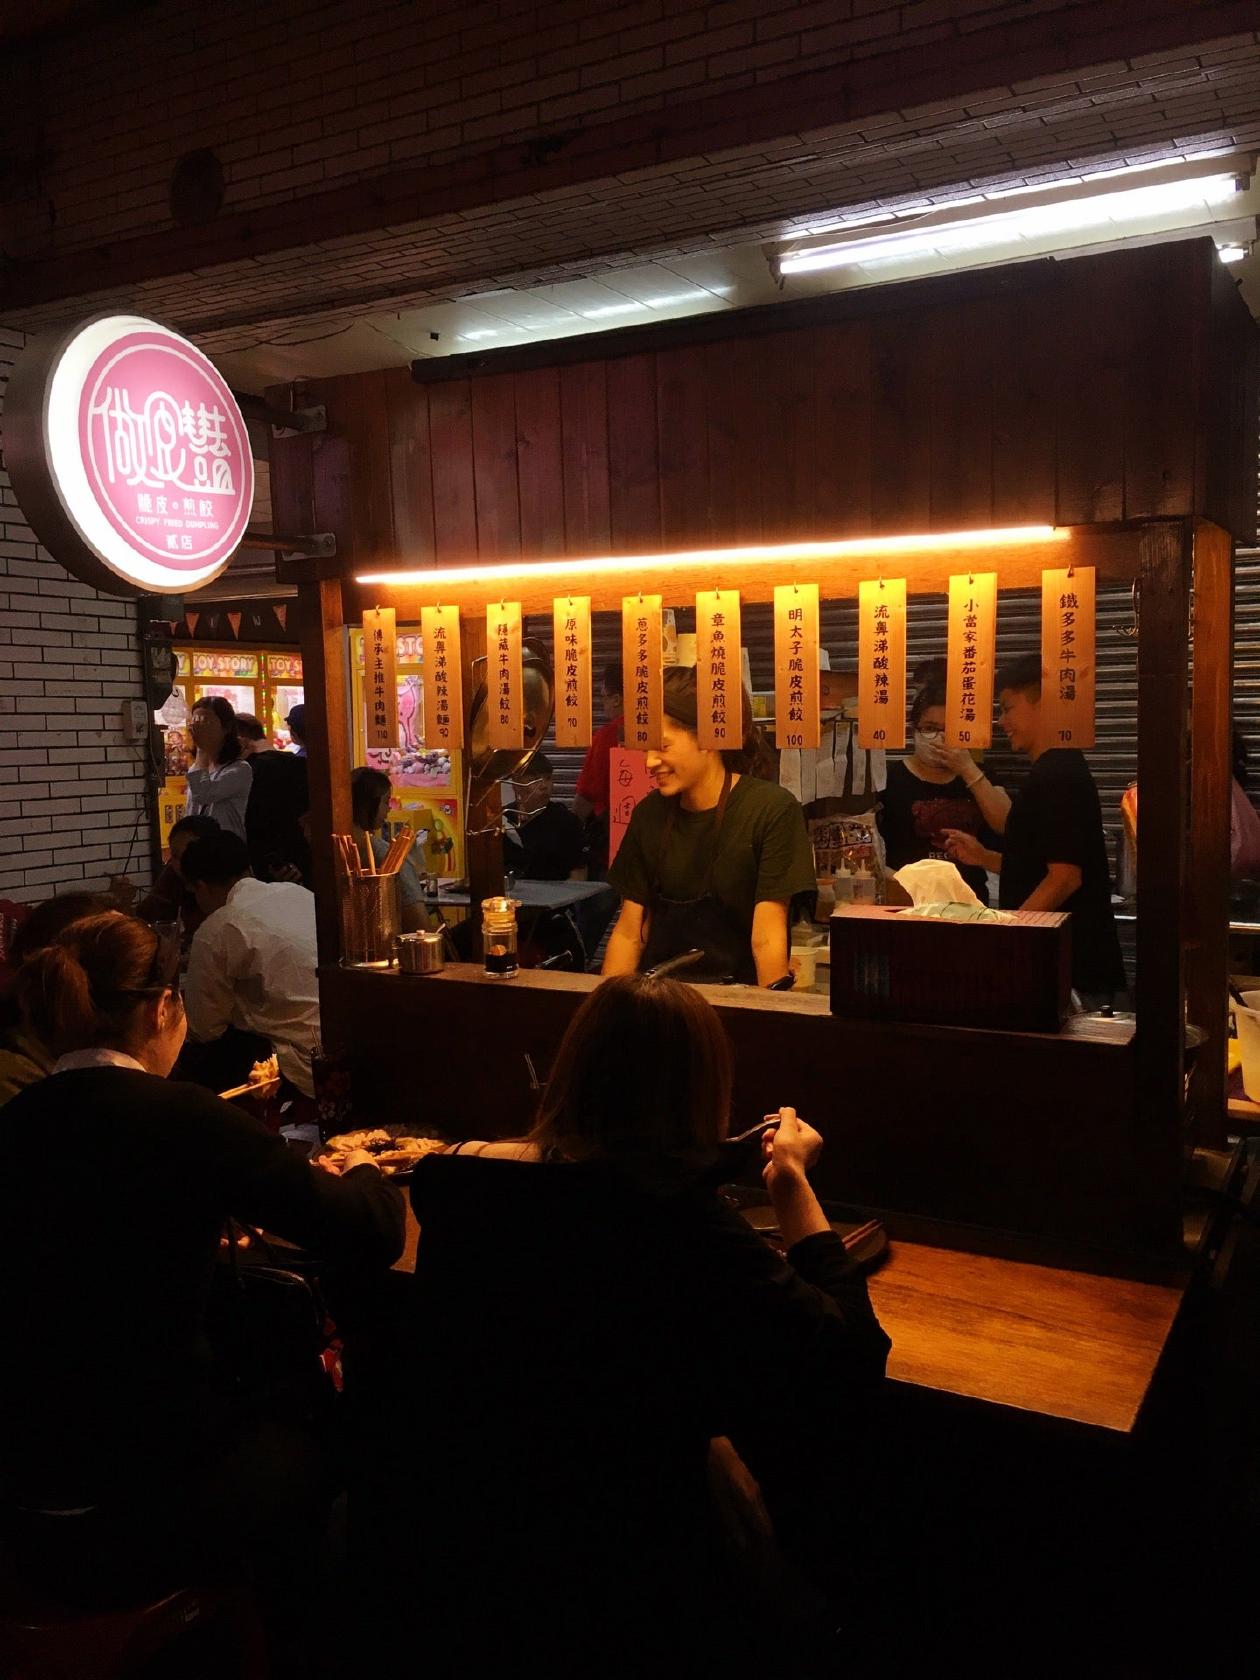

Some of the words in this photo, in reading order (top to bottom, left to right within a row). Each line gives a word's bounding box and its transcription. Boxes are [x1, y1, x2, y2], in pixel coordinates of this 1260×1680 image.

[135, 515, 161, 527] CRISPY
[163, 518, 184, 528] FRIED
[1058, 592, 1080, 702] 鐵多多牛肉湯
[872, 604, 891, 705] 流鼻涕酸辣湯
[959, 598, 980, 722] 小當家番茄蛋花湯
[193, 653, 214, 669] TOY
[217, 654, 255, 670] STORY
[270, 658, 291, 671] TOY
[564, 617, 579, 707] 原味脆皮煎餃
[709, 612, 727, 724] 章魚燒脆皮煎餃
[787, 607, 804, 722] 明太子脆皮煎餃
[567, 717, 578, 728] 70
[376, 729, 388, 740] 110
[438, 727, 449, 738] 90
[713, 727, 726, 739] 90
[872, 729, 886, 741] 40
[958, 730, 971, 742] 50
[1058, 730, 1072, 741] 70
[786, 734, 804, 746] 100
